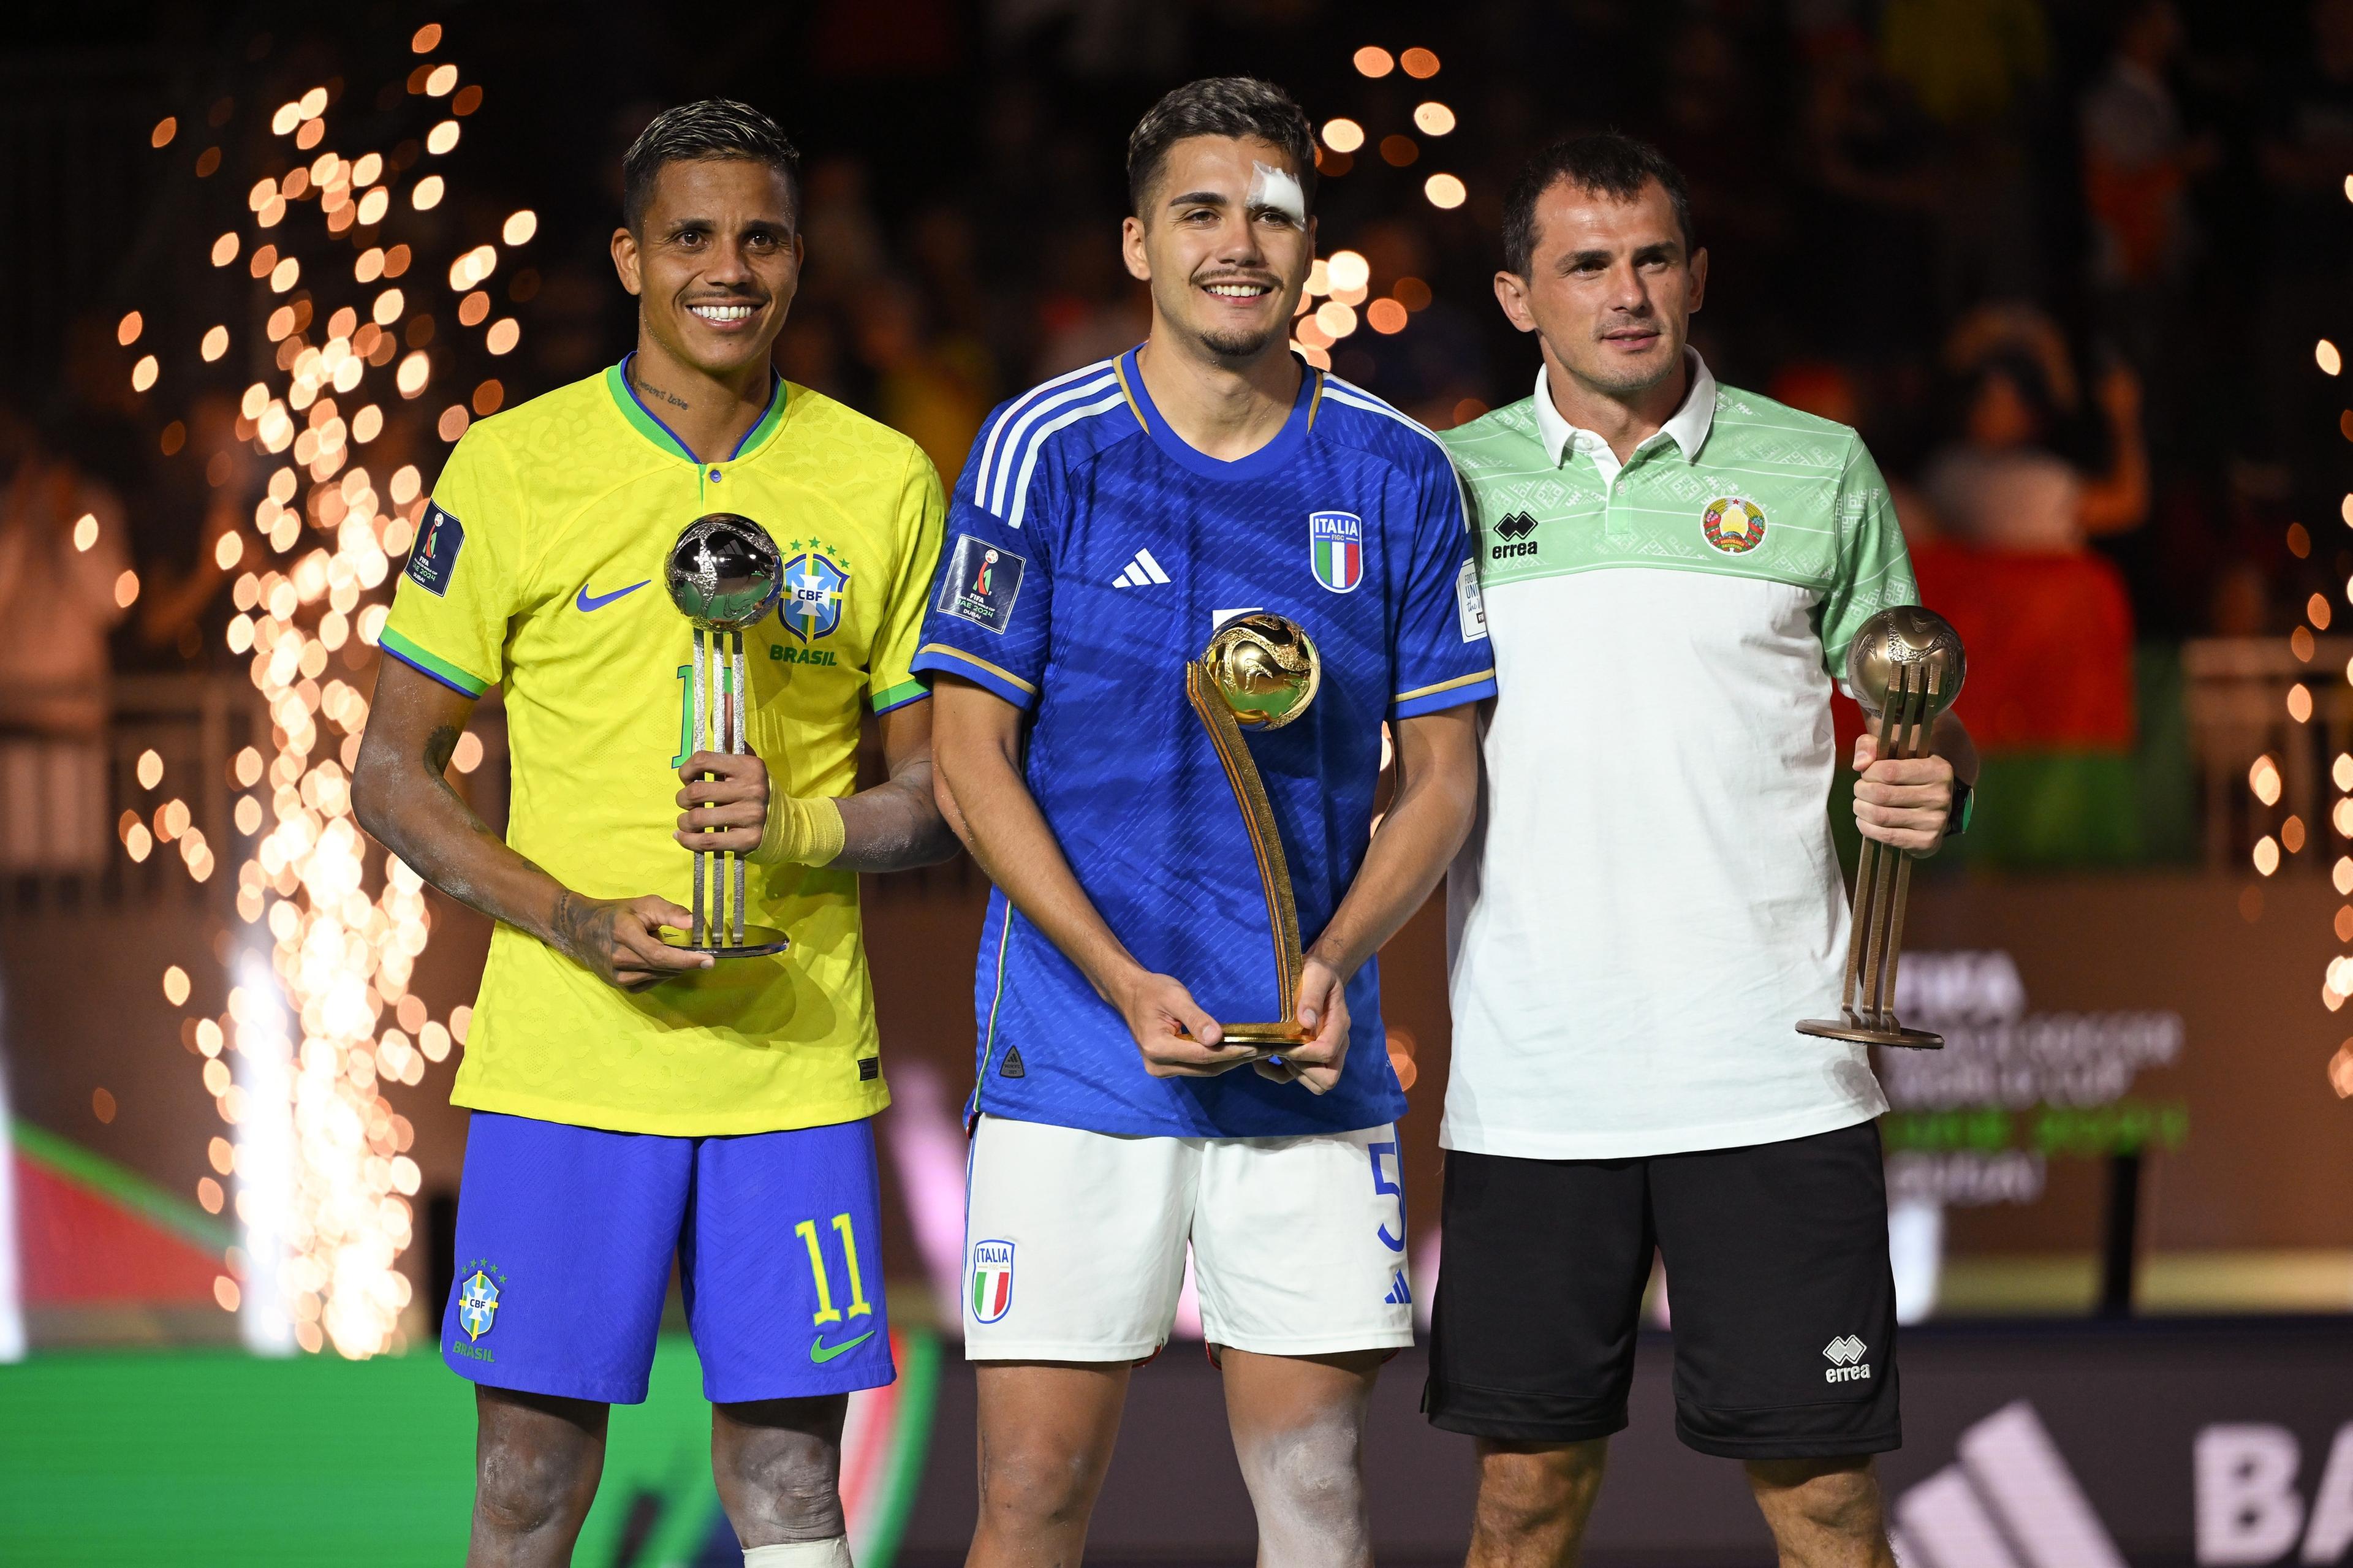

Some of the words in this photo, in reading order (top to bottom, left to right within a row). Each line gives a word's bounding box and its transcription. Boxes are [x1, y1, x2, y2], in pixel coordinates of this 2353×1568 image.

[1315, 518, 1358, 536] ITALIA
[1492, 541, 1537, 559] errea
[419, 556, 429, 567] FIFA
[421, 570, 436, 581] 2024
[1464, 572, 1476, 585] FOOT
[798, 589, 823, 601] CBF
[969, 593, 984, 604] FIFA
[1466, 583, 1478, 599] UNI
[963, 609, 981, 619] DUBAI
[973, 606, 993, 618] 2024
[770, 644, 837, 667] BRASIL
[1368, 1142, 1406, 1252] 5
[977, 1248, 1009, 1263] ITALIA
[795, 1212, 872, 1327] 11
[470, 1299, 486, 1309] CBF
[453, 1340, 495, 1363] BRASIL
[1825, 1364, 1871, 1383] errea
